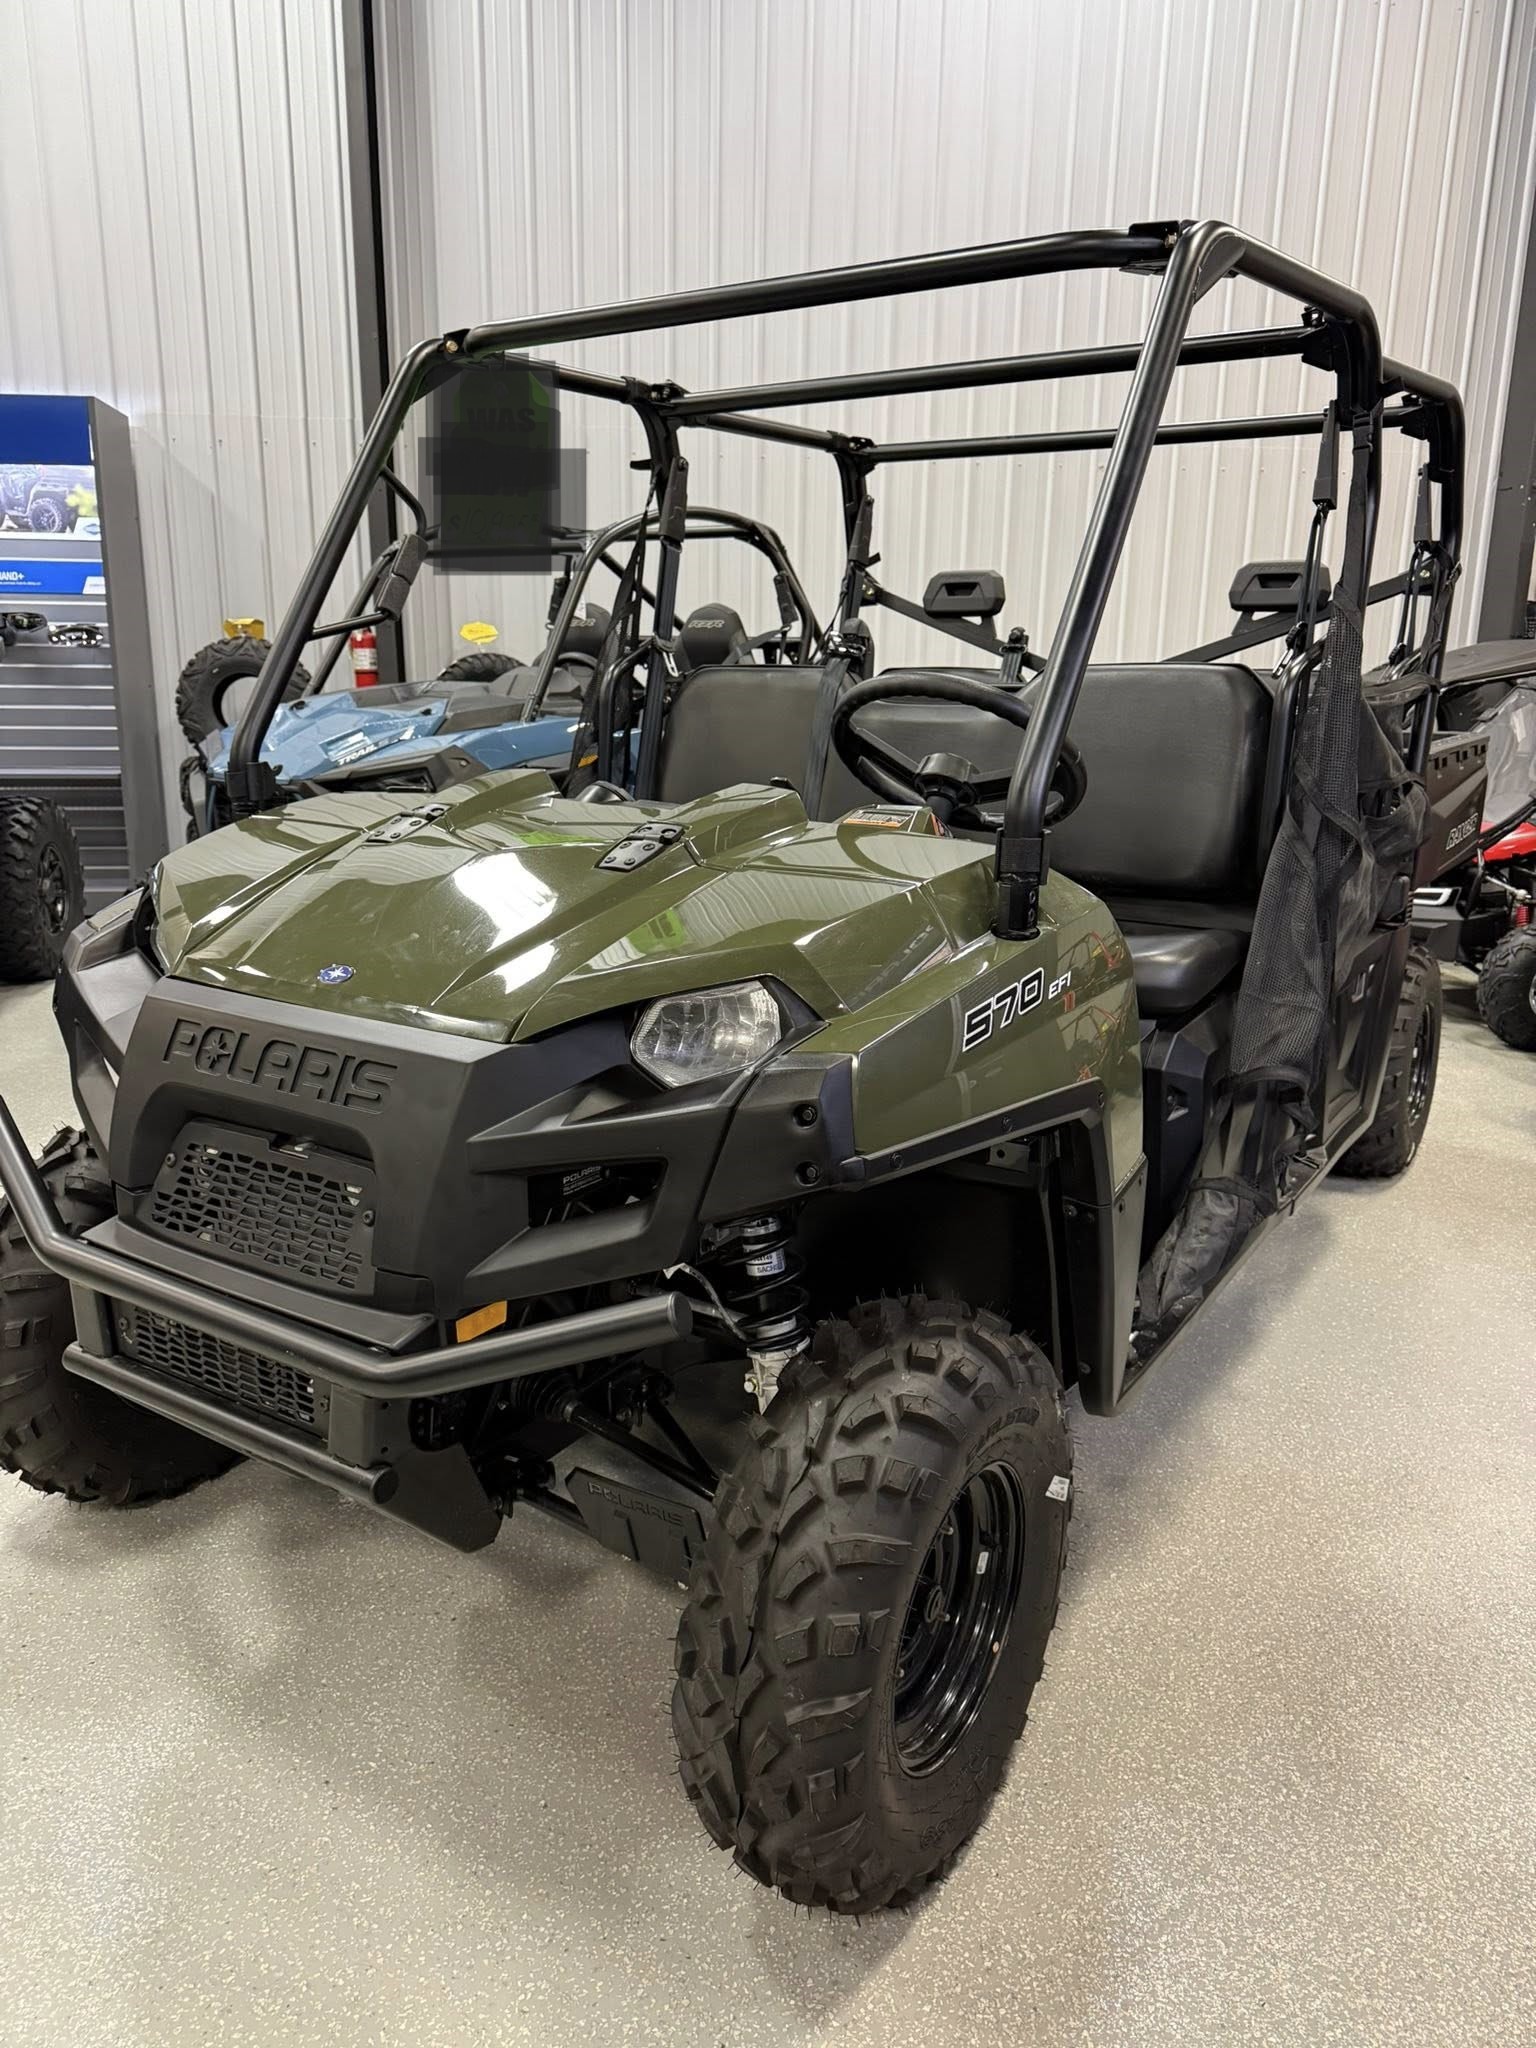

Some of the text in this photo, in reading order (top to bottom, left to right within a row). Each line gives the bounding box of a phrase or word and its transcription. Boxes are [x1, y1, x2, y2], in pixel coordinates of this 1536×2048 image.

[962, 966, 1072, 1053] 570 EFI
[162, 1017, 399, 1115] POLARIS
[562, 1165, 602, 1185] POLARIS
[586, 1481, 686, 1528] POLARIS
